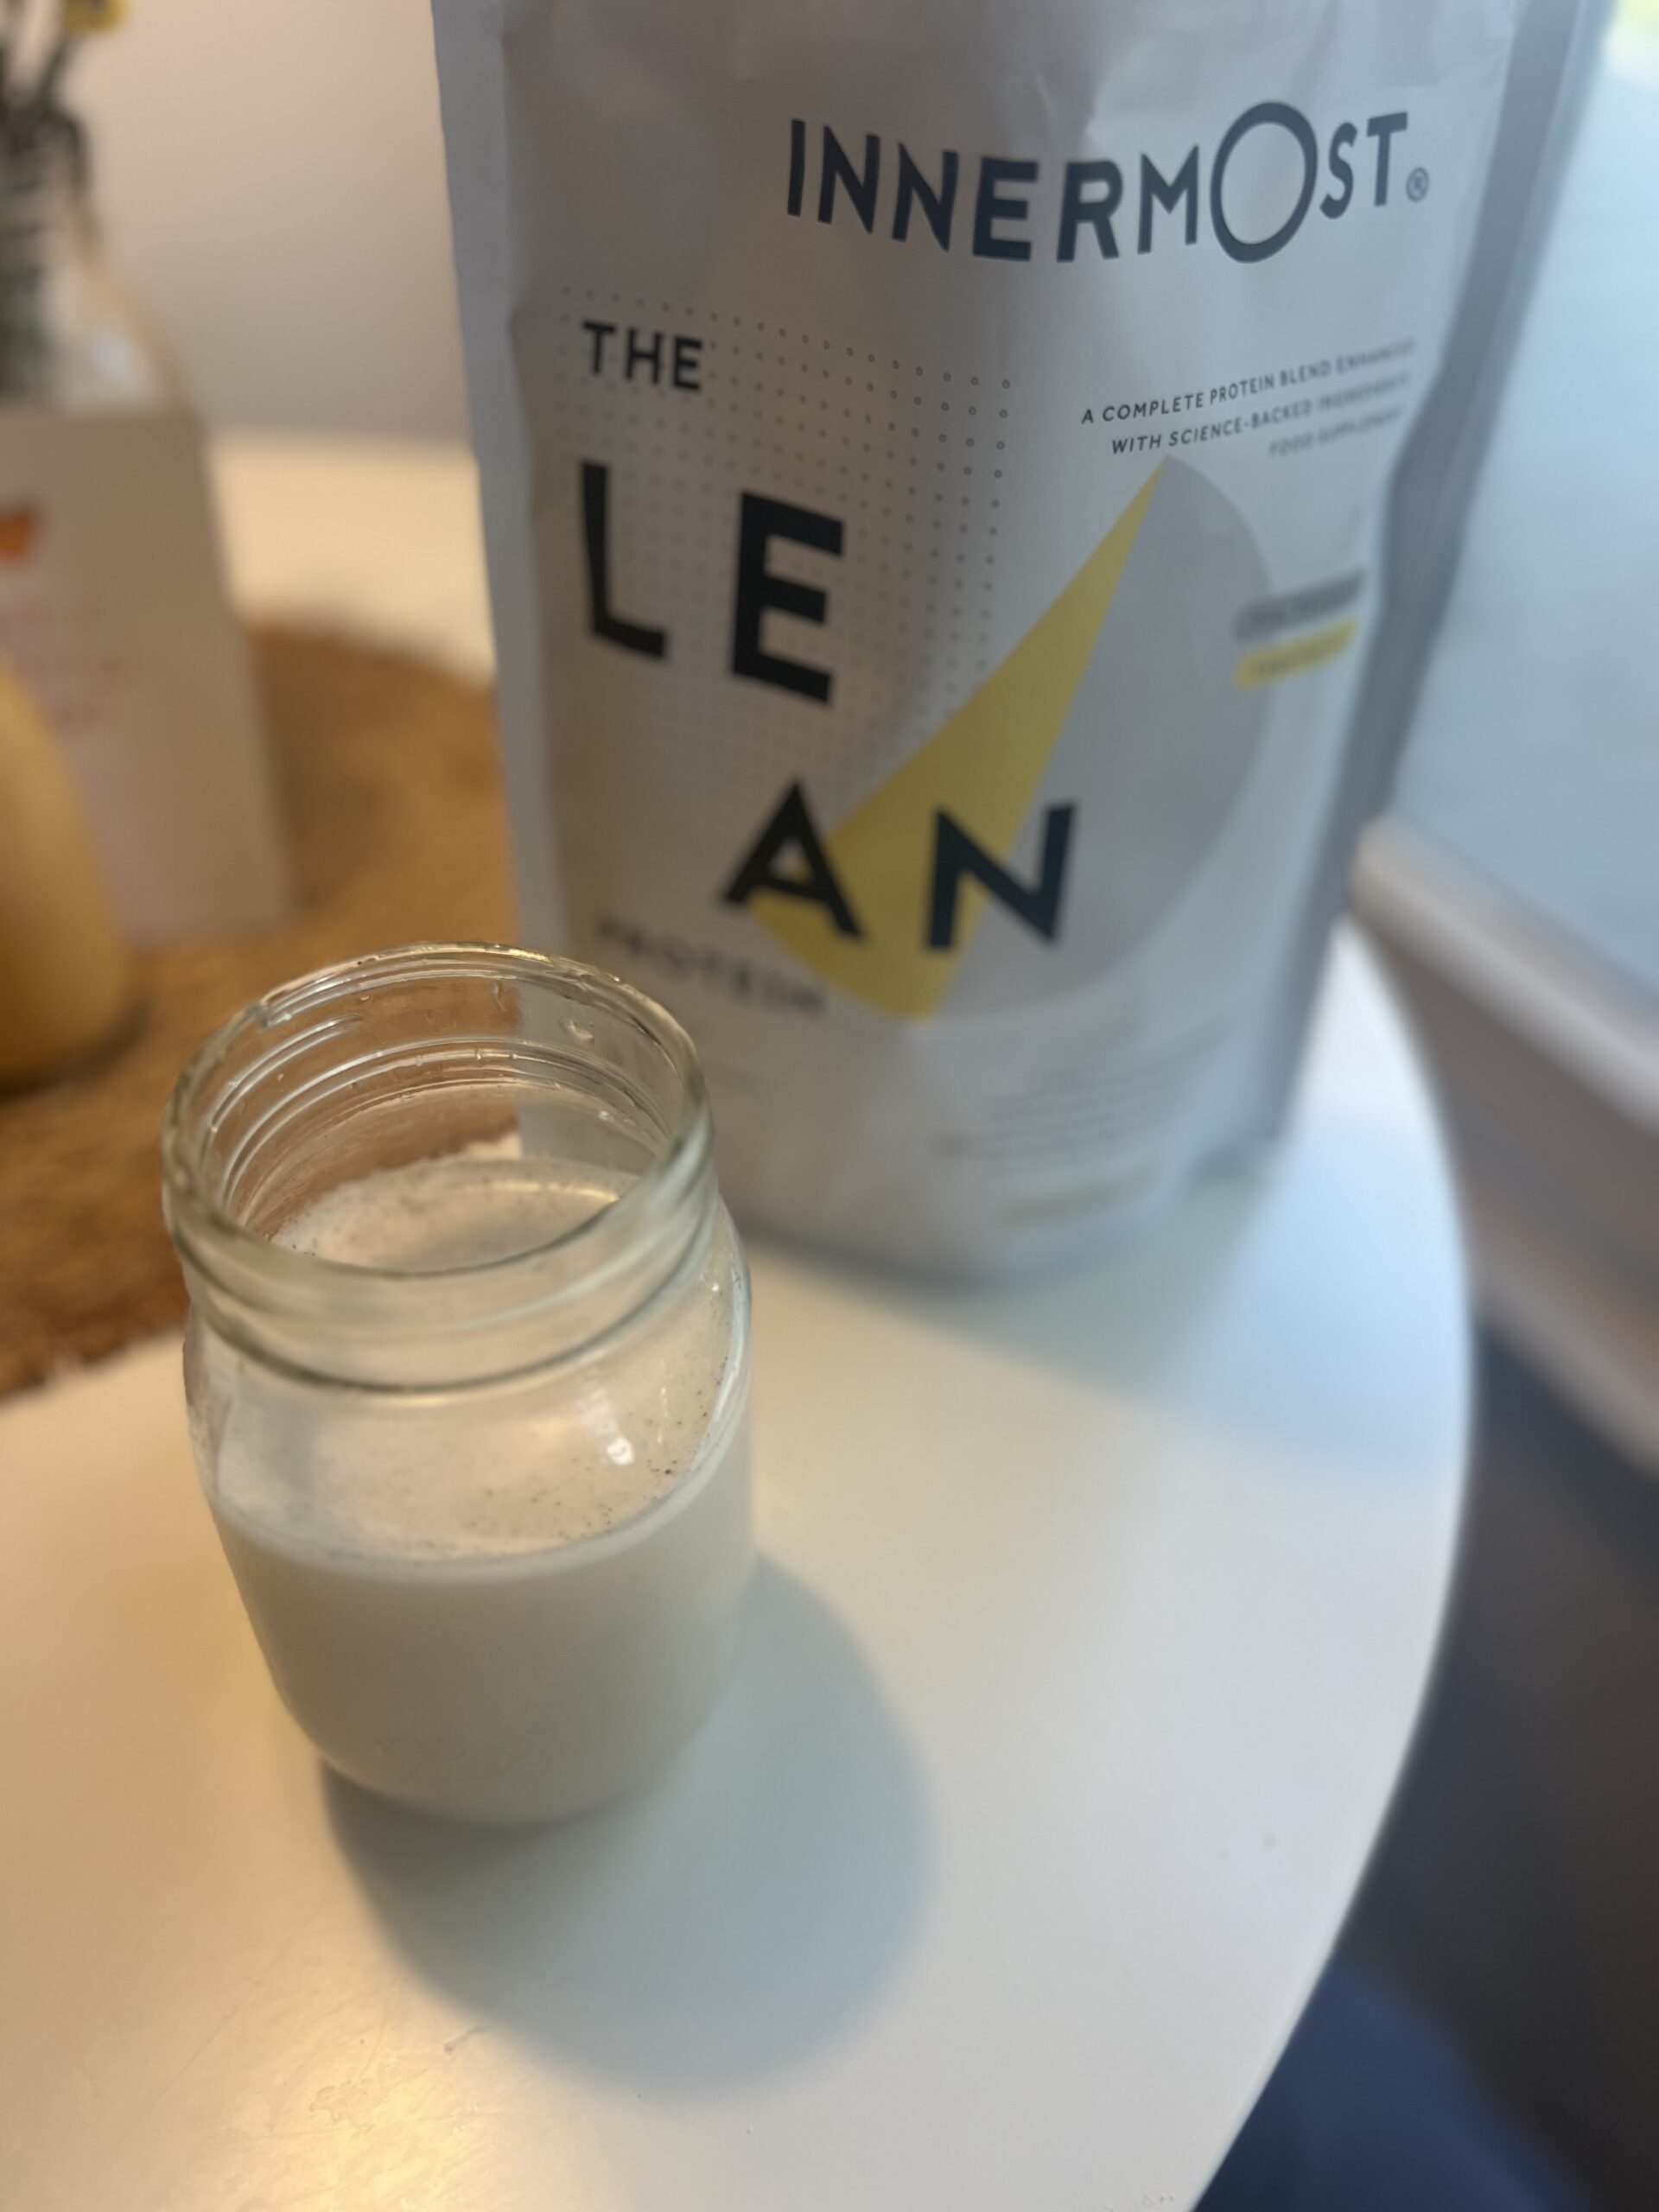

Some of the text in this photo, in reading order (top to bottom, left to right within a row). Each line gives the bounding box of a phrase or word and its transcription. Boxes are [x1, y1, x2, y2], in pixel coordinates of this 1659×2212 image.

[582, 320, 702, 391] THE
[1082, 407, 1094, 424] A
[1102, 392, 1205, 422] COMPLETE
[1210, 373, 1275, 405] PROTEIN
[1280, 359, 1332, 387] BLEND
[1112, 434, 1162, 454] WITH
[1168, 399, 1313, 447] SCIENCE-BACKED
